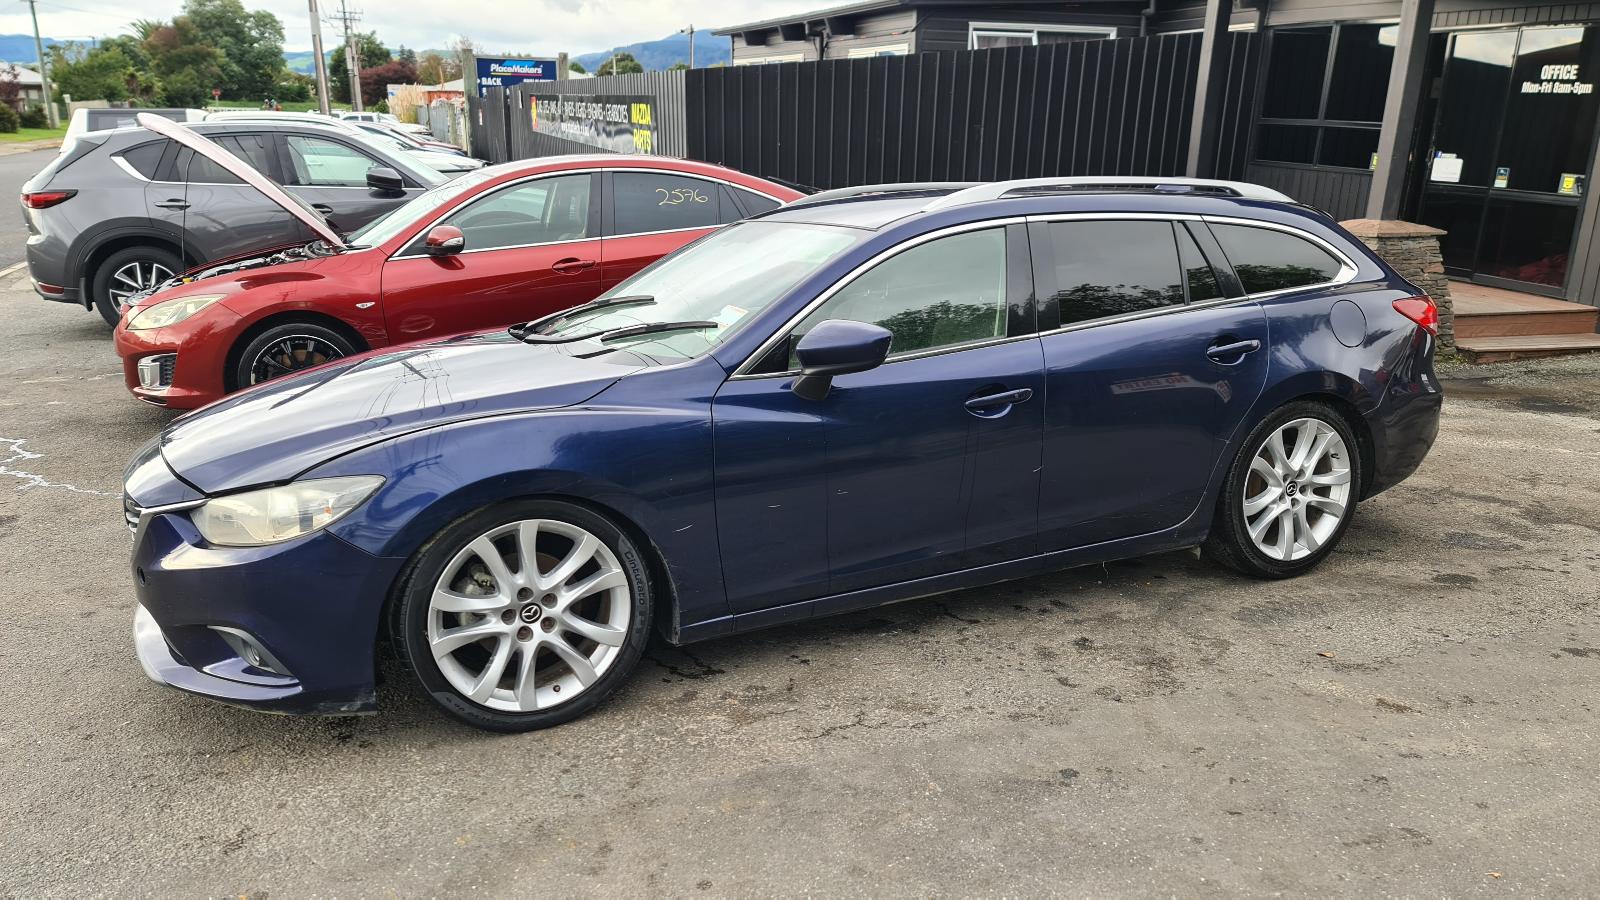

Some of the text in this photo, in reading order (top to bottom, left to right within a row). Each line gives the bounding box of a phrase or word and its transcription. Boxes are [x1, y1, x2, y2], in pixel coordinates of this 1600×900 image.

[490, 63, 543, 74] PlaceMakers
[1540, 64, 1579, 80] OFFICE
[481, 77, 502, 86] BACK
[1521, 81, 1593, 95] Mon-Fri 8am-5pm
[631, 103, 651, 125] MAZDA
[633, 128, 651, 153] PARTS
[655, 188, 709, 206] 2576
